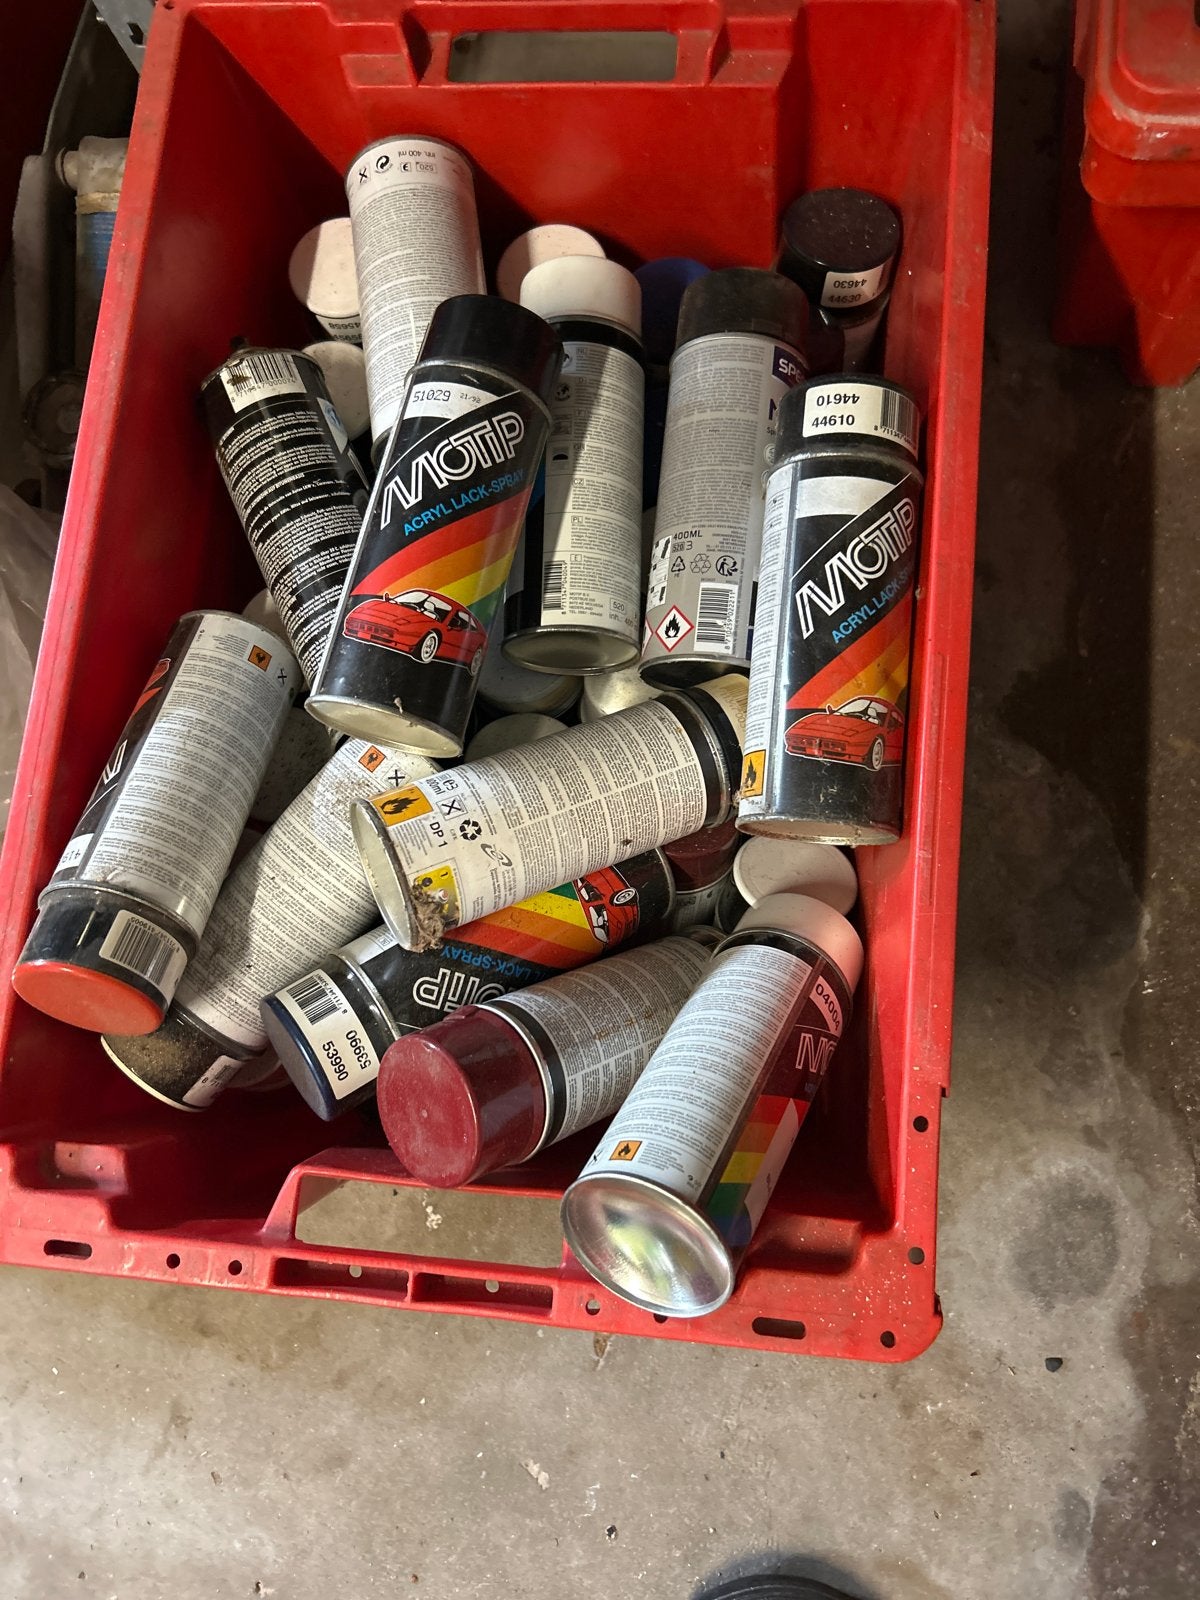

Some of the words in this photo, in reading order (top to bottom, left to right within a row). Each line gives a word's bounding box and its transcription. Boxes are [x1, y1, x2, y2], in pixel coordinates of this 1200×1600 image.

[833, 278, 867, 289] 44630
[827, 293, 862, 304] 44630
[412, 389, 451, 403] 51029
[816, 393, 860, 407] 44610
[811, 414, 855, 428] 44610
[379, 411, 525, 530] MOTIP
[403, 503, 452, 536] ACRYL
[450, 469, 525, 510] LACK-SPRAY
[673, 529, 703, 541] 400ML
[795, 497, 915, 638] MOTIP
[612, 601, 625, 612] 520
[728, 592, 736, 616] 022211
[831, 604, 877, 644] ACRYL
[429, 821, 445, 839] DP
[438, 840, 448, 848] 1
[440, 944, 532, 978] LACK-SPRAY
[815, 983, 841, 1032] 04004
[321, 1041, 349, 1081] 53990
[345, 1030, 372, 1070] 53990
